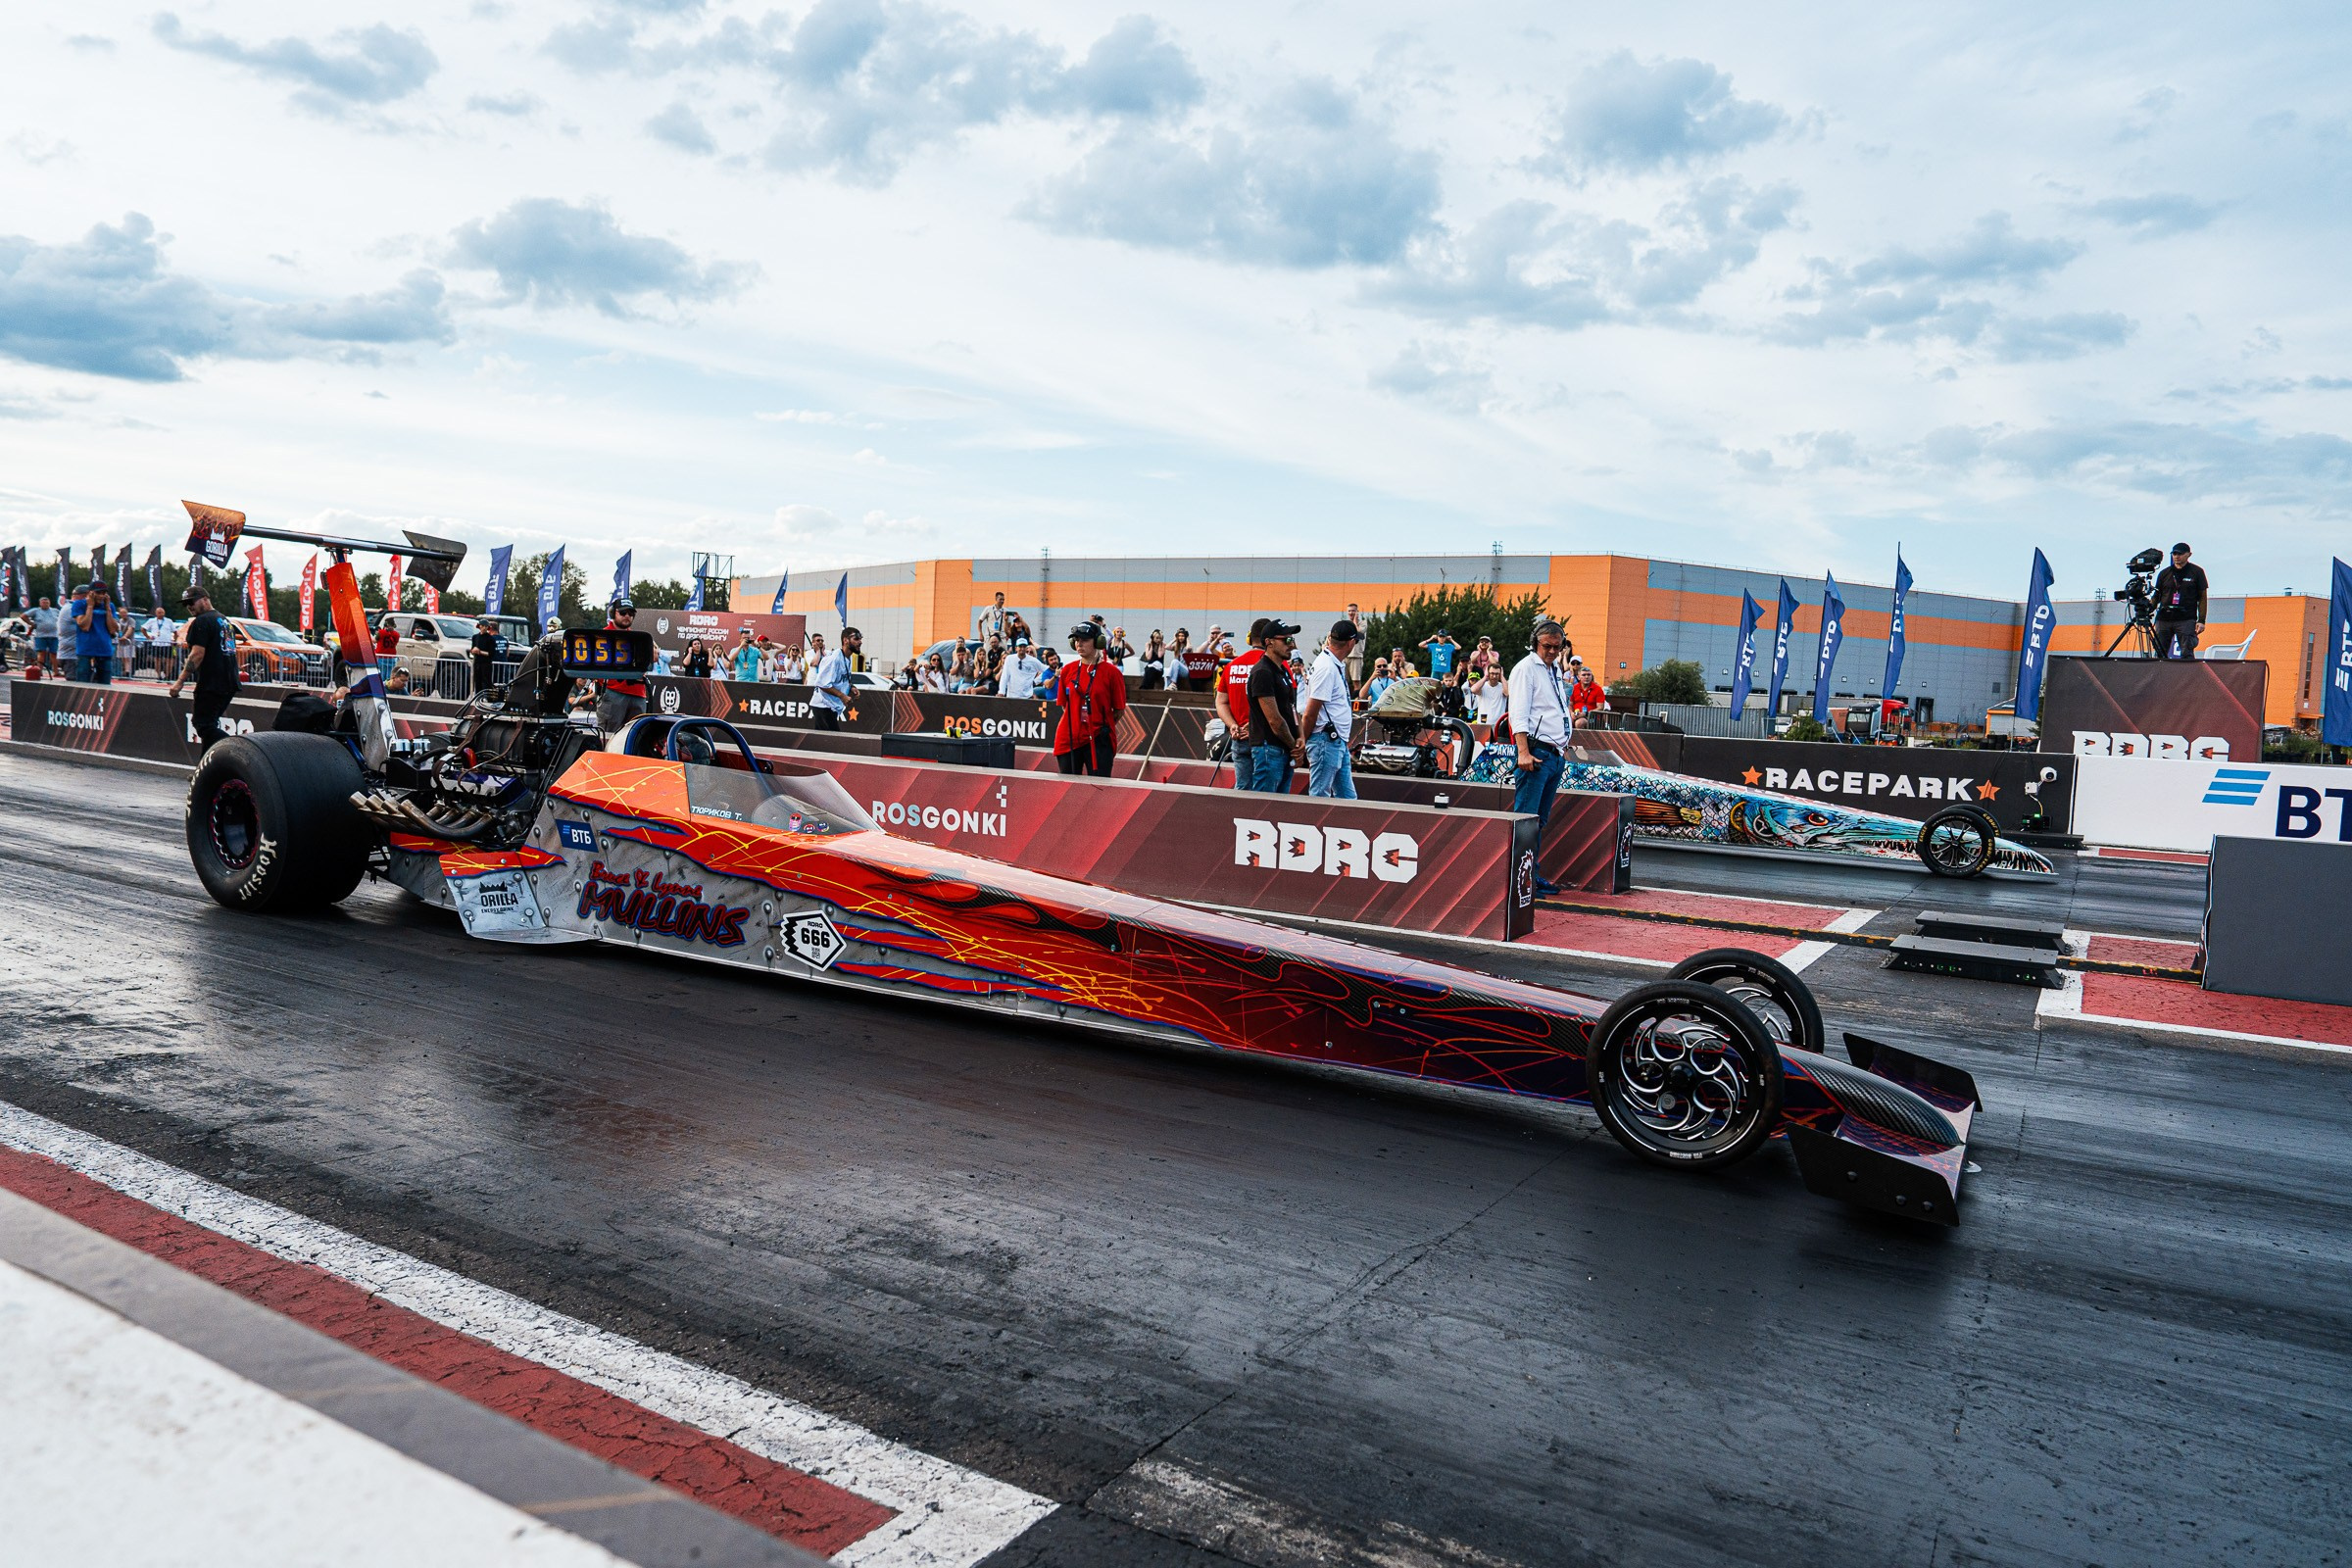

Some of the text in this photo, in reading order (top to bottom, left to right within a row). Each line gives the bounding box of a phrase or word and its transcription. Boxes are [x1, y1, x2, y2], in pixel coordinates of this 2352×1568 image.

[206, 540, 227, 557] GORILLA
[1188, 661, 1213, 671] 357M
[48, 710, 104, 731] ROSGONKI
[750, 700, 847, 721] RACEPK
[944, 715, 1046, 739] ROSGONKI
[1765, 767, 1974, 802] RACEPARK
[691, 806, 743, 821] ТЮРИКОВ Т.
[872, 801, 1006, 836] ROSGONKI
[571, 828, 592, 845] ВТБ
[1233, 817, 1419, 883] RDRC
[238, 832, 277, 901] Hoosier
[590, 860, 631, 886] Bruce
[480, 893, 519, 907] ORILLA
[578, 880, 751, 948] MULLINS
[801, 927, 830, 949] 666
